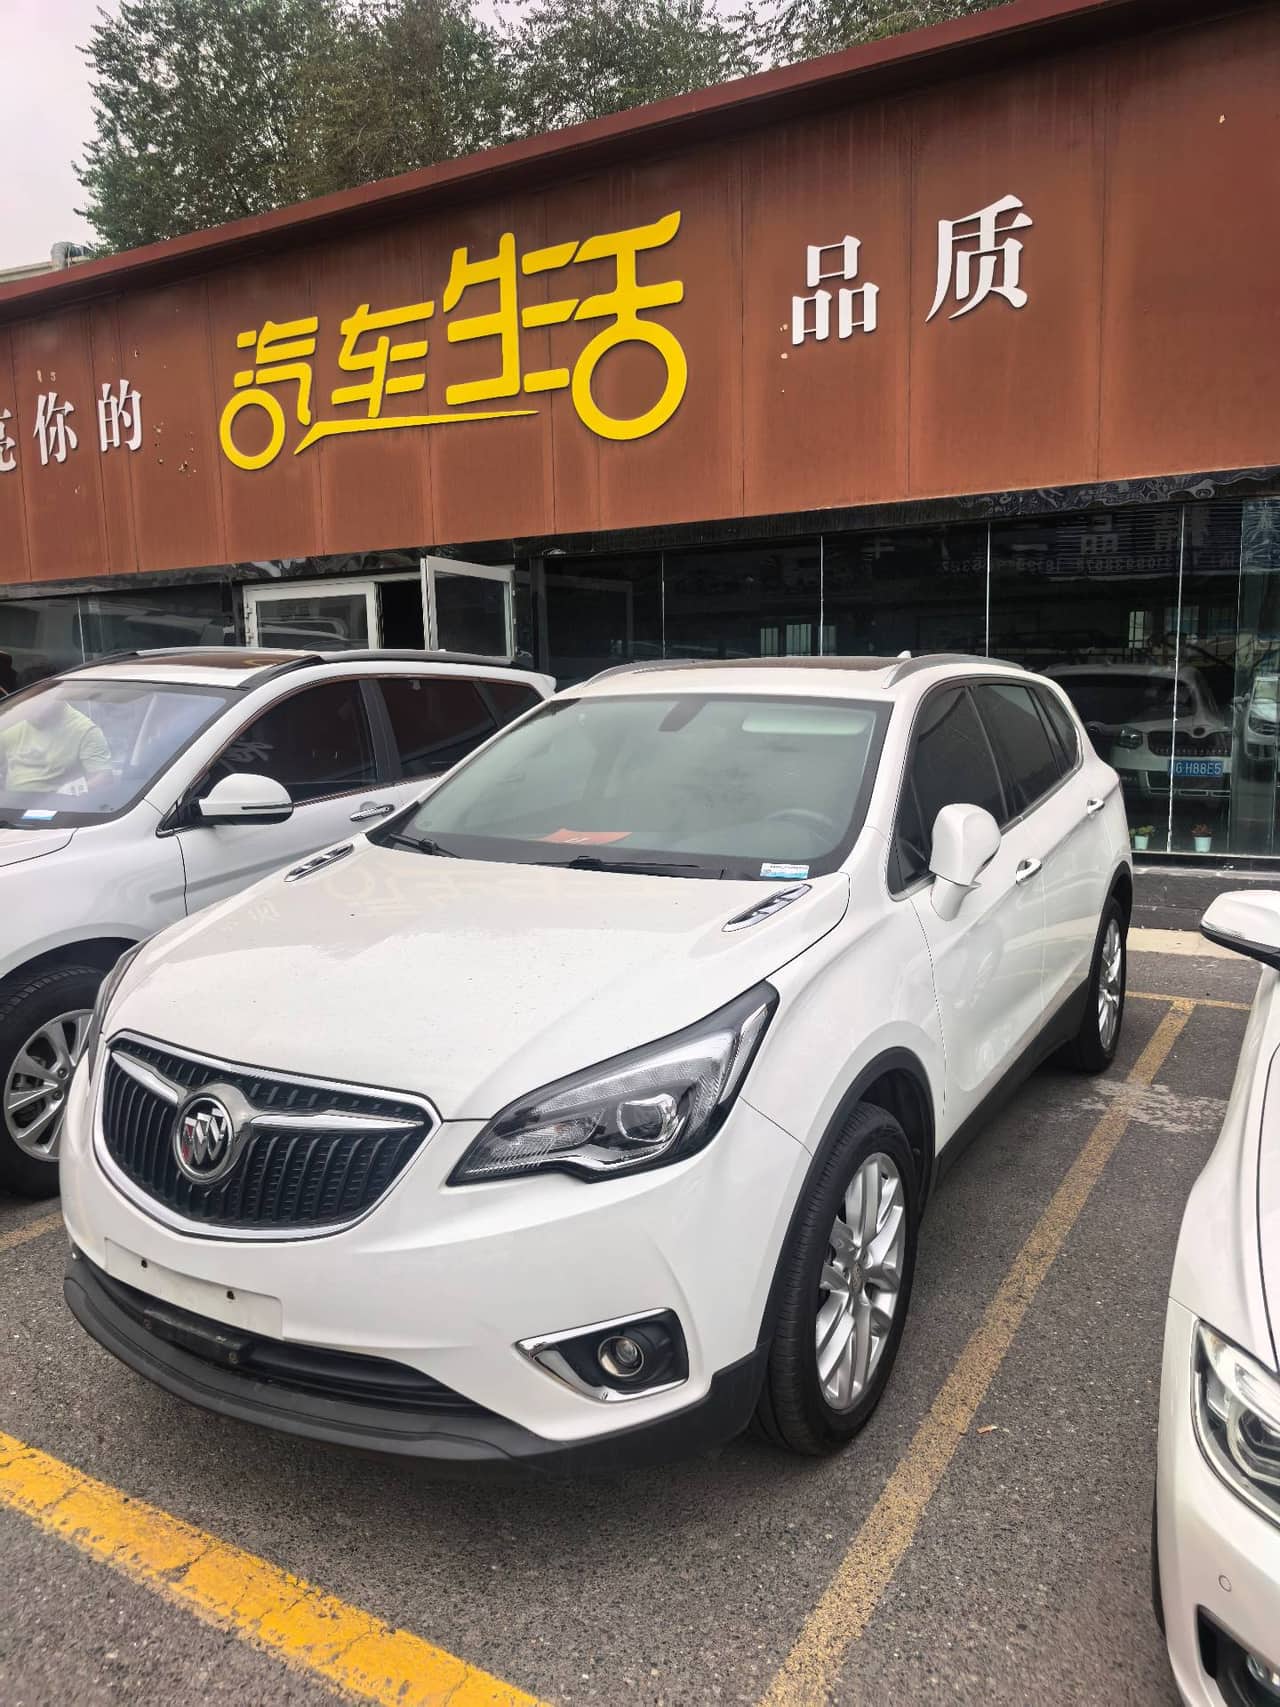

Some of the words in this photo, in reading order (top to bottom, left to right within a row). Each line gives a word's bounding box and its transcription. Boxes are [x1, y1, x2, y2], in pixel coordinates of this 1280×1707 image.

[219, 210, 688, 470] 汽车生活
[792, 194, 1033, 345] 品质
